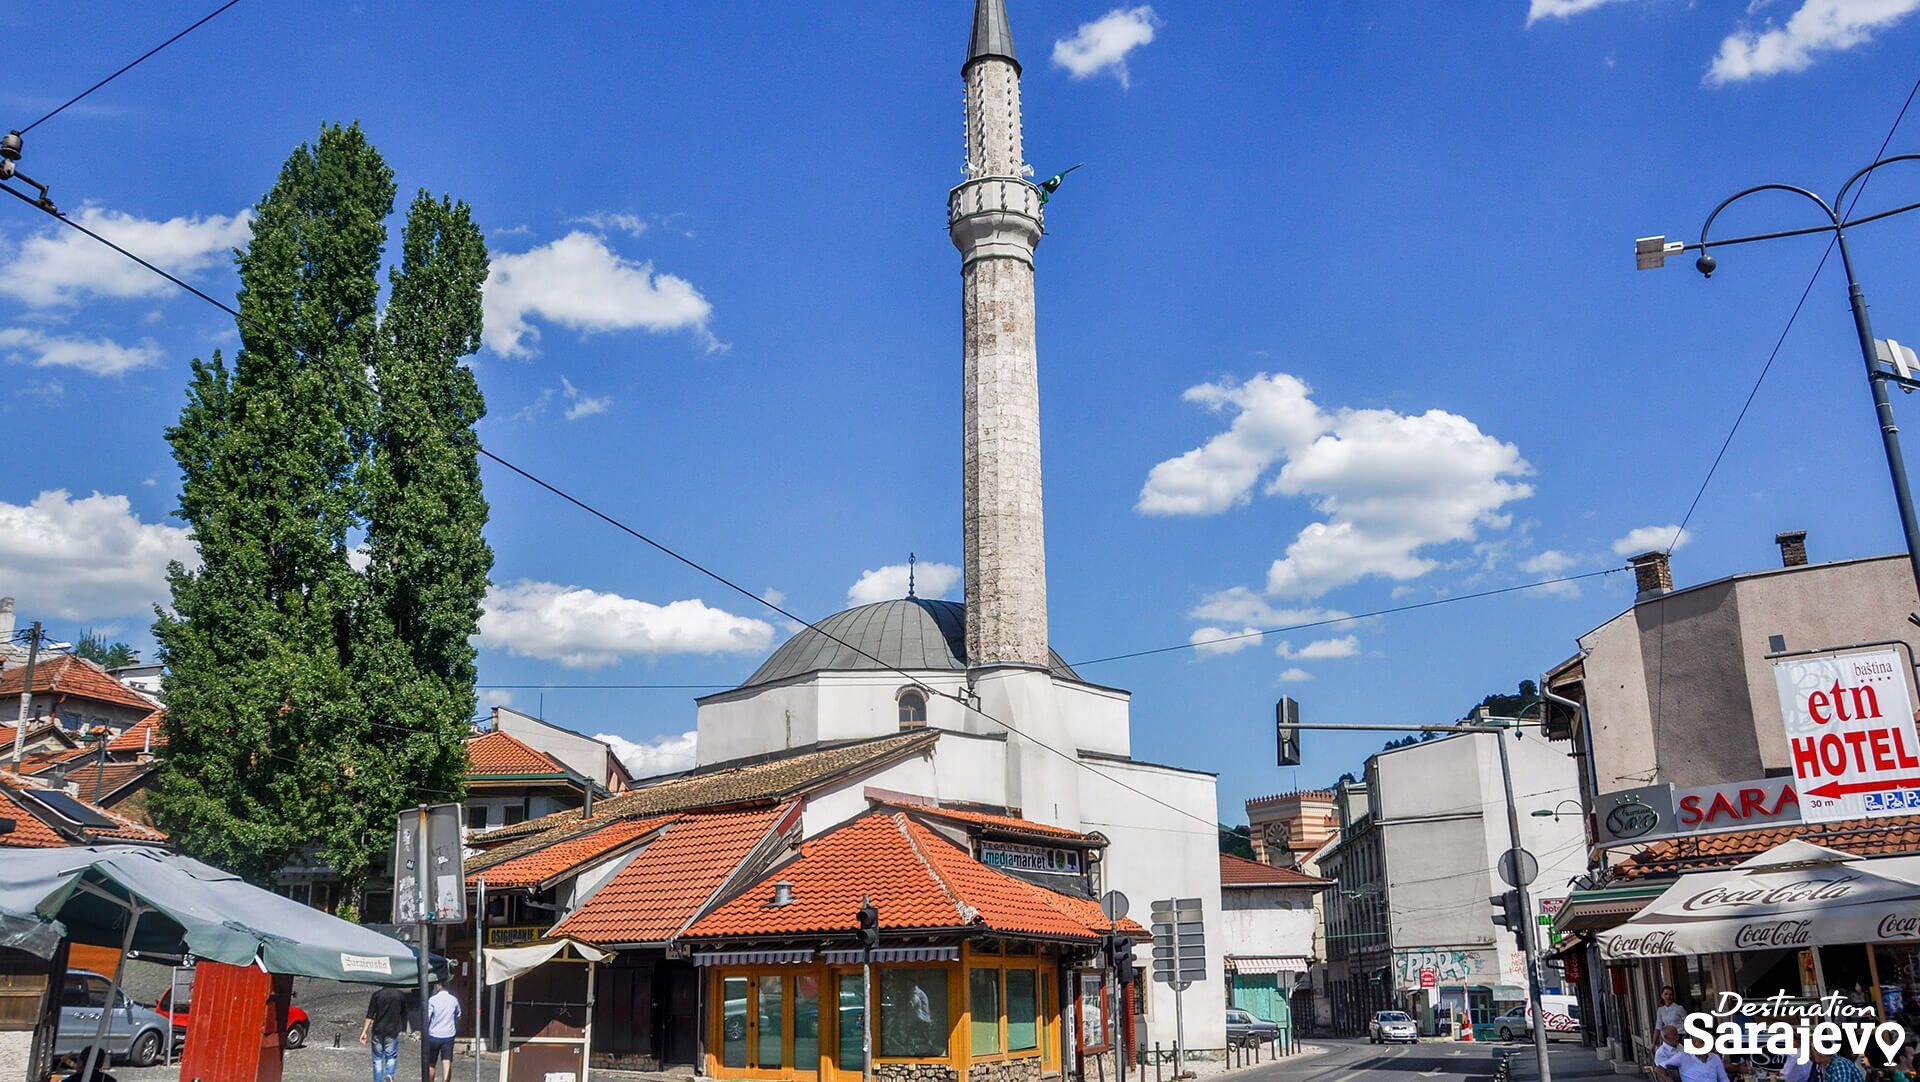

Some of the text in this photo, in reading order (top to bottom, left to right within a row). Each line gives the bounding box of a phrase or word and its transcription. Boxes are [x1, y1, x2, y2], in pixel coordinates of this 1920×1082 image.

[1853, 660, 1893, 677] baština
[1808, 678, 1883, 725] etn
[1791, 727, 1920, 780] HOTEL
[1679, 784, 1800, 825] SARA
[1810, 799, 1822, 808] 30
[985, 850, 1046, 869] mediamarket
[1682, 874, 1865, 911] Coca-Cola
[1606, 930, 1679, 958] Coca-Cola
[1735, 919, 1813, 949] Coca-Cola
